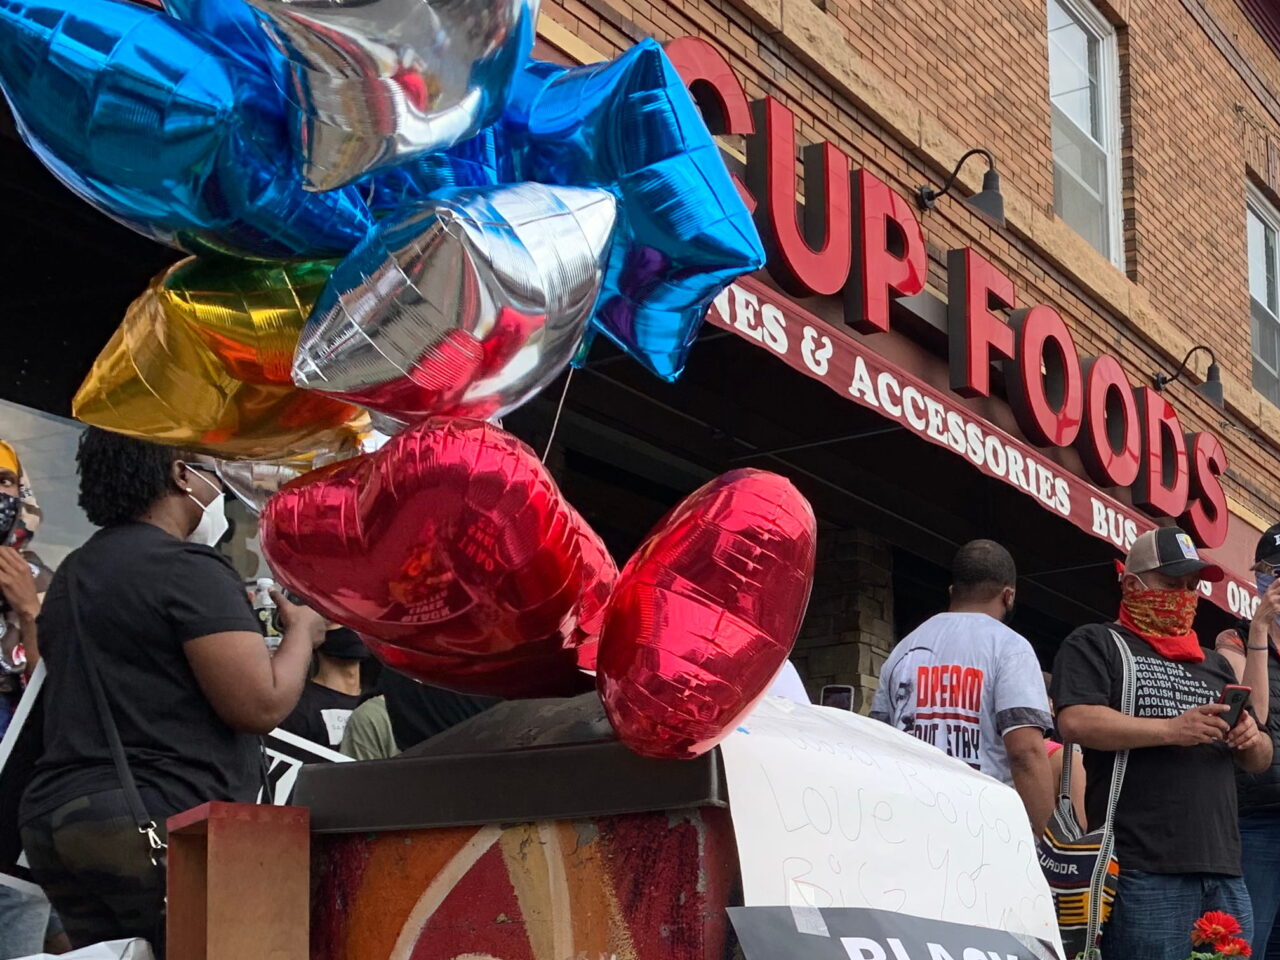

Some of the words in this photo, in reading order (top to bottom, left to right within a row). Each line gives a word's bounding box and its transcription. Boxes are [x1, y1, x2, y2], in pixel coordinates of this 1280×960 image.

[950, 247, 1229, 549] FOODS
[801, 326, 834, 376] &
[848, 356, 1072, 517] ACCESSORIES
[1170, 676, 1200, 687] Prisons
[1137, 688, 1174, 698] ABOLISH
[1175, 692, 1207, 704] Binaries
[1138, 697, 1176, 707] ABOLISH
[1139, 708, 1178, 716] ABOLISH
